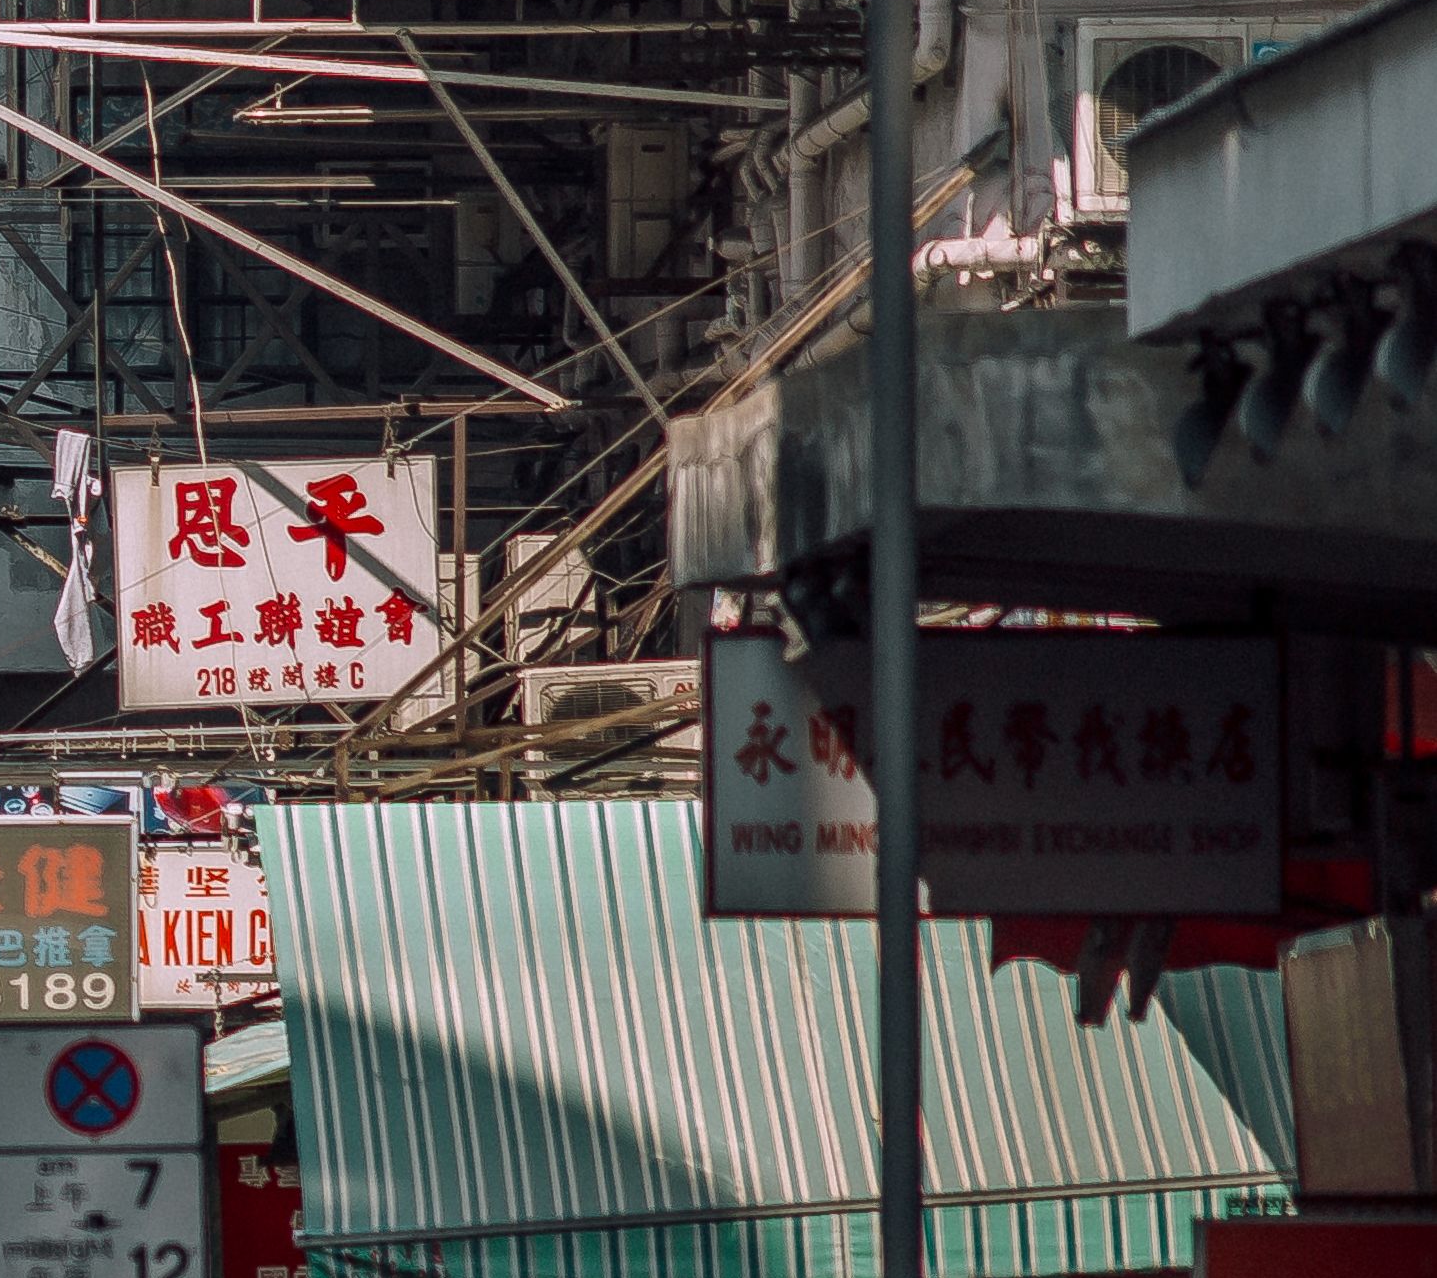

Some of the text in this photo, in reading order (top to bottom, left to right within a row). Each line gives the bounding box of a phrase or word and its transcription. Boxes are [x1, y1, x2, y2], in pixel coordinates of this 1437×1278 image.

[733, 701, 1257, 789] 永明民幣找換店
[732, 822, 803, 854] WING
[163, 909, 233, 967] KIEN
[126, 1159, 162, 1210] 7
